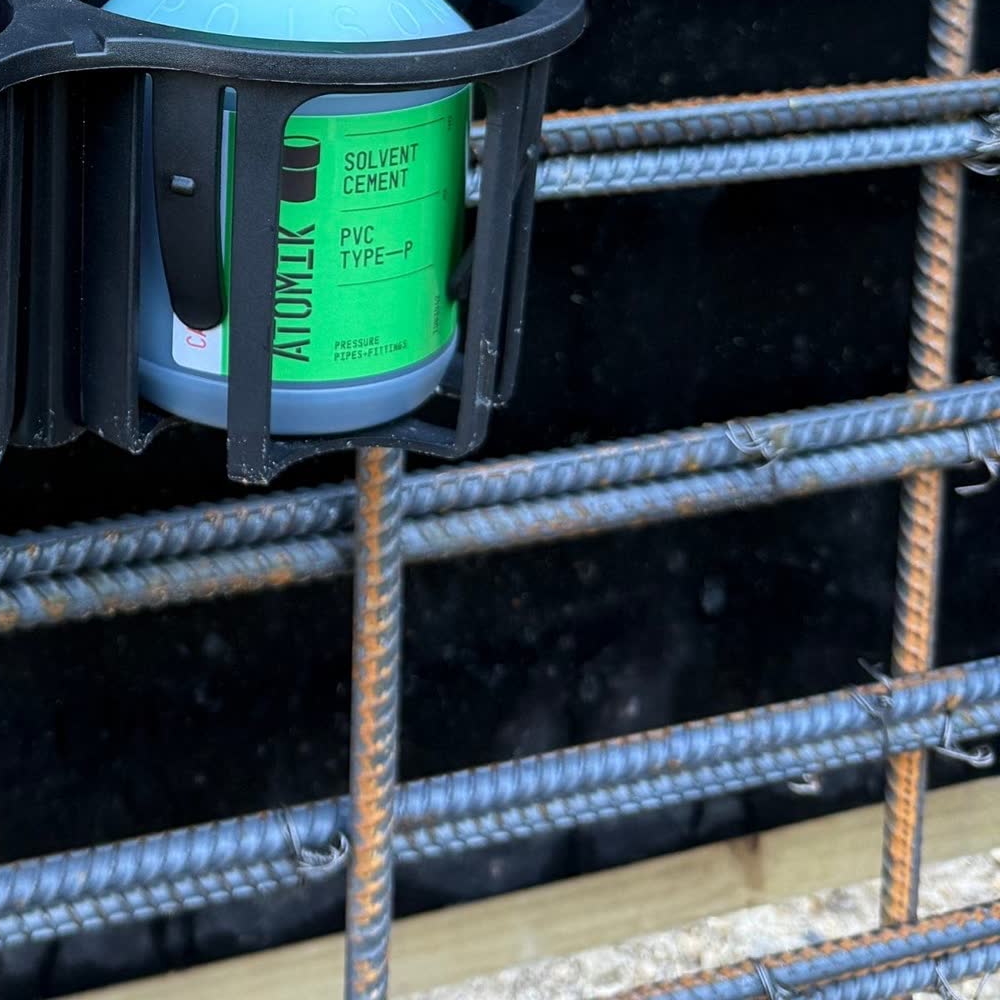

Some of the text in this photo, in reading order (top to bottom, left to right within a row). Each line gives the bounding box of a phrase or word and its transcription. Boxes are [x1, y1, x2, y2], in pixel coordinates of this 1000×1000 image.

[344, 143, 419, 171] SOLVENT
[343, 168, 409, 195] CEMENT
[340, 225, 375, 247] PVC
[272, 223, 315, 362] ATOMIK
[334, 335, 380, 350] PRESSURE
